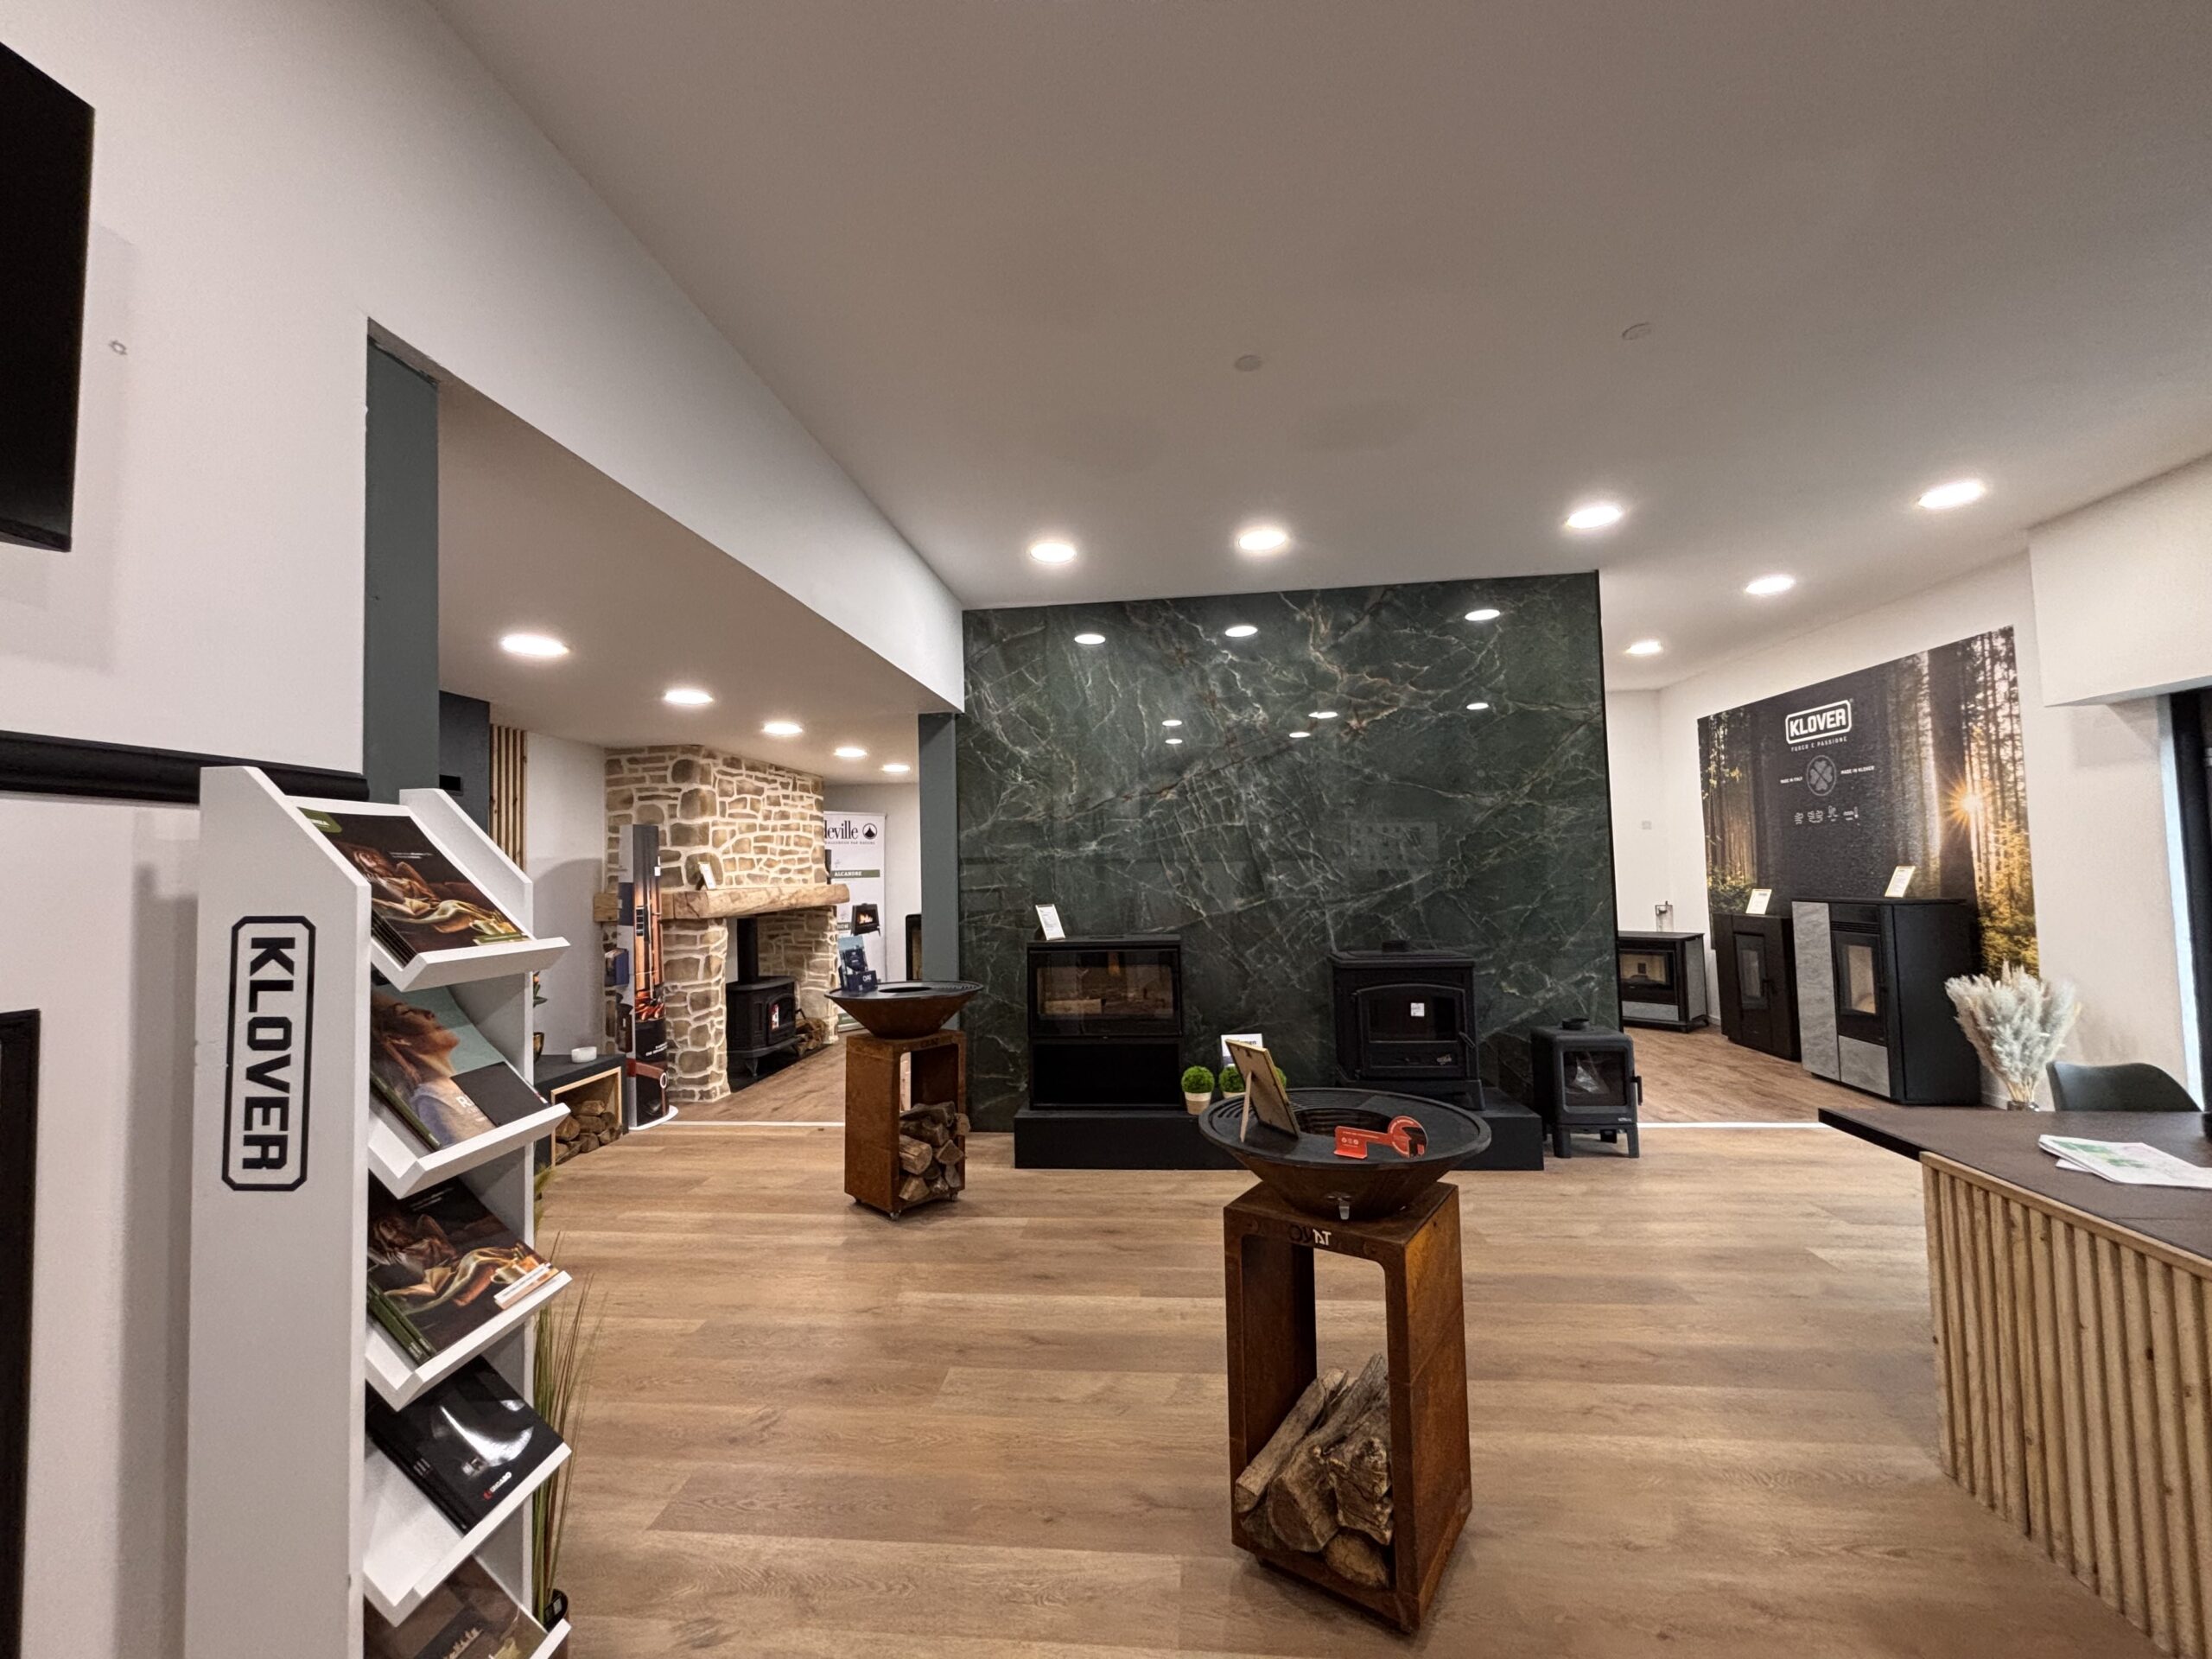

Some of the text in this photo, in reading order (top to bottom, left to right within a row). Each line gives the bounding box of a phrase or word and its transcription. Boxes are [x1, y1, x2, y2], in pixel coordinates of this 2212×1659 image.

[1789, 709, 1847, 737] KLOVER
[1817, 736, 1847, 747] PASSIONE
[242, 937, 296, 1169] KLOVER
